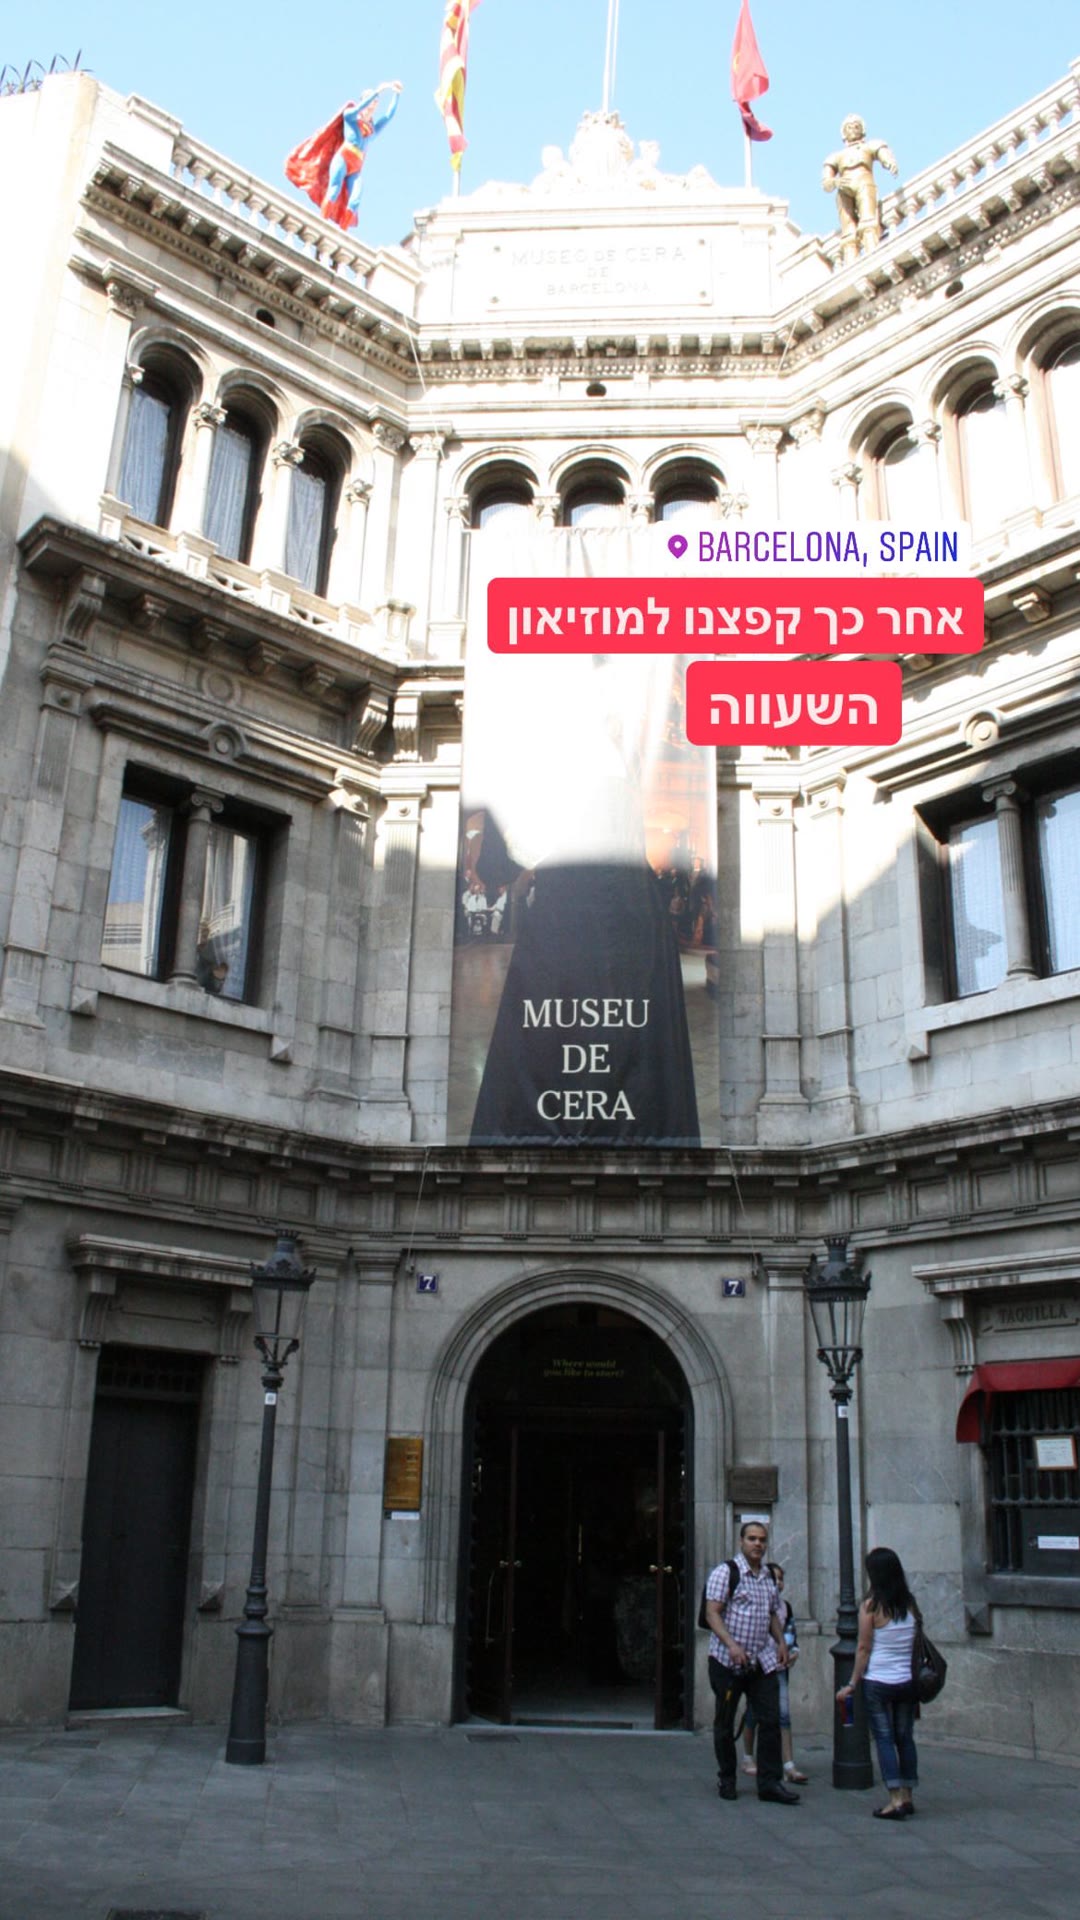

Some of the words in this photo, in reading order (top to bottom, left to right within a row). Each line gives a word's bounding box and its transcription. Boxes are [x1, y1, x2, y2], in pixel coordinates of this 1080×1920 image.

[522, 998, 650, 1028] MUSEU
[562, 1044, 611, 1074] DE
[537, 1090, 636, 1121] CERA
[423, 1276, 433, 1289] 7
[729, 1281, 739, 1294] 7
[999, 1304, 1068, 1324] TAQUILLA
